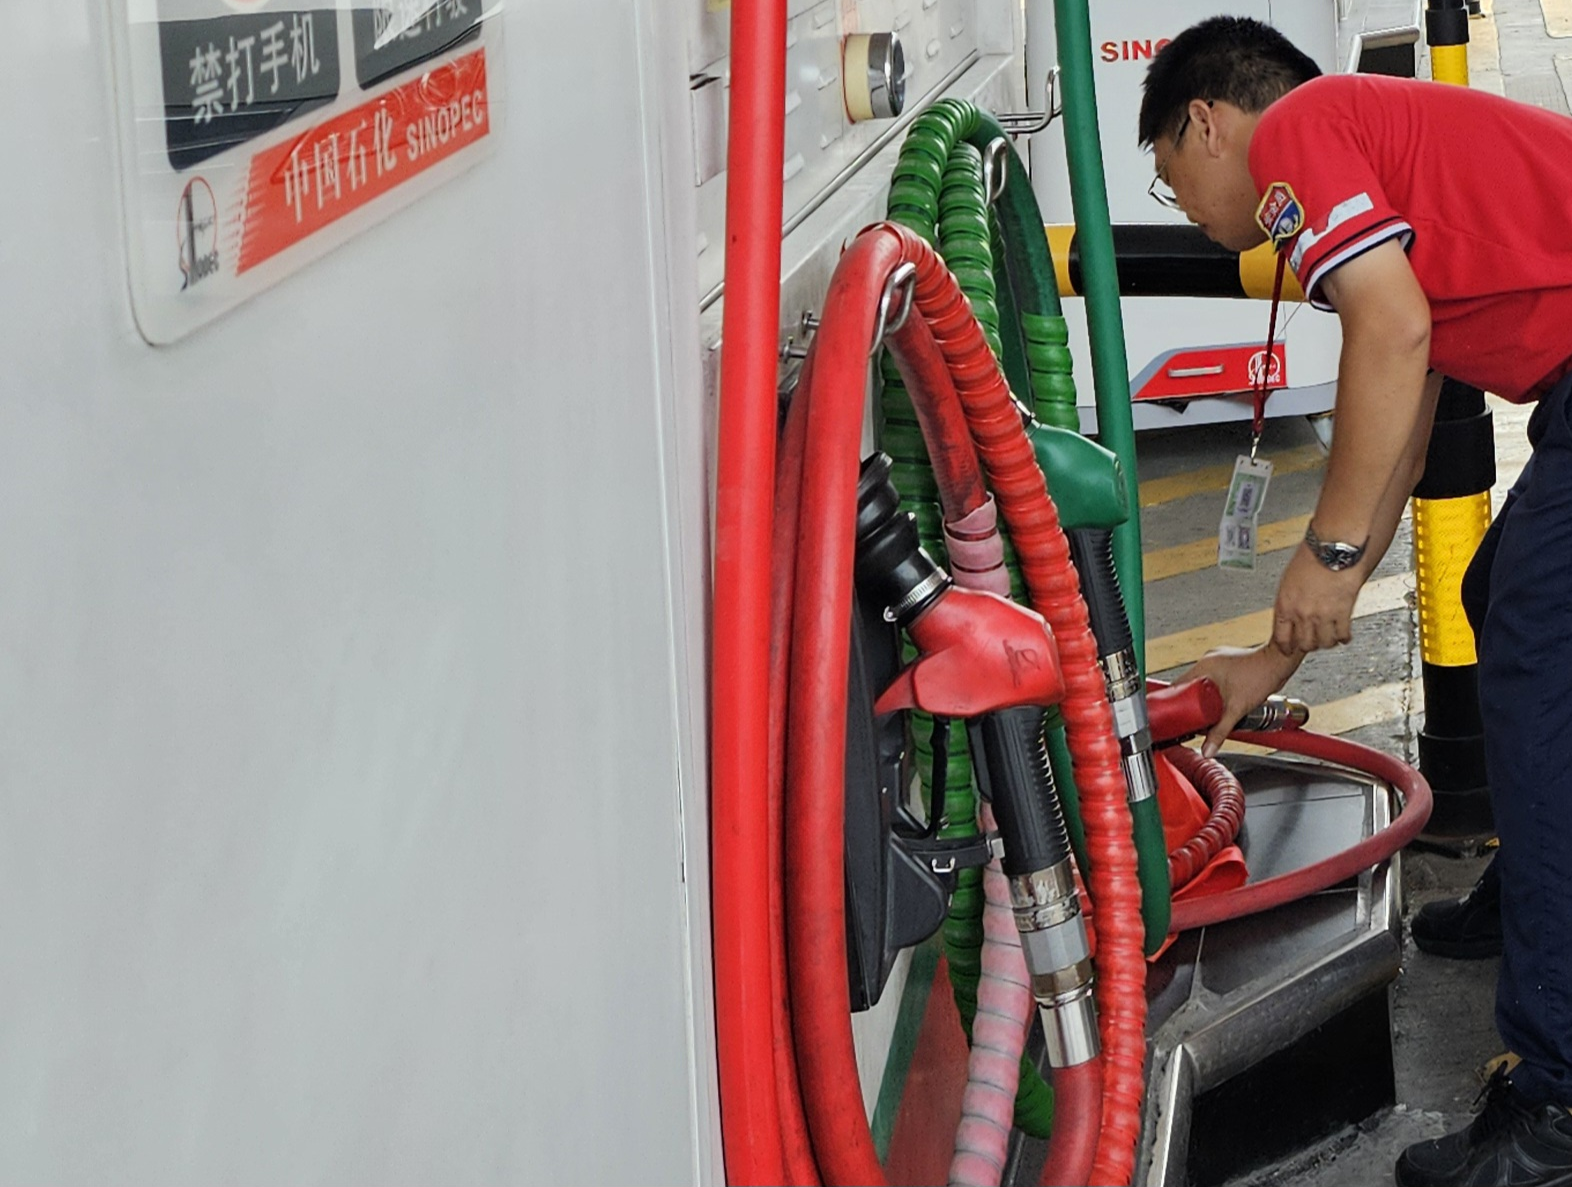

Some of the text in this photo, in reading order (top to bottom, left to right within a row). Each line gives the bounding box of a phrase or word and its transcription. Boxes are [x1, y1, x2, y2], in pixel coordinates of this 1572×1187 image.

[189, 14, 320, 125] 禁打手机
[284, 92, 484, 224] 中国石化 SINOPEC
